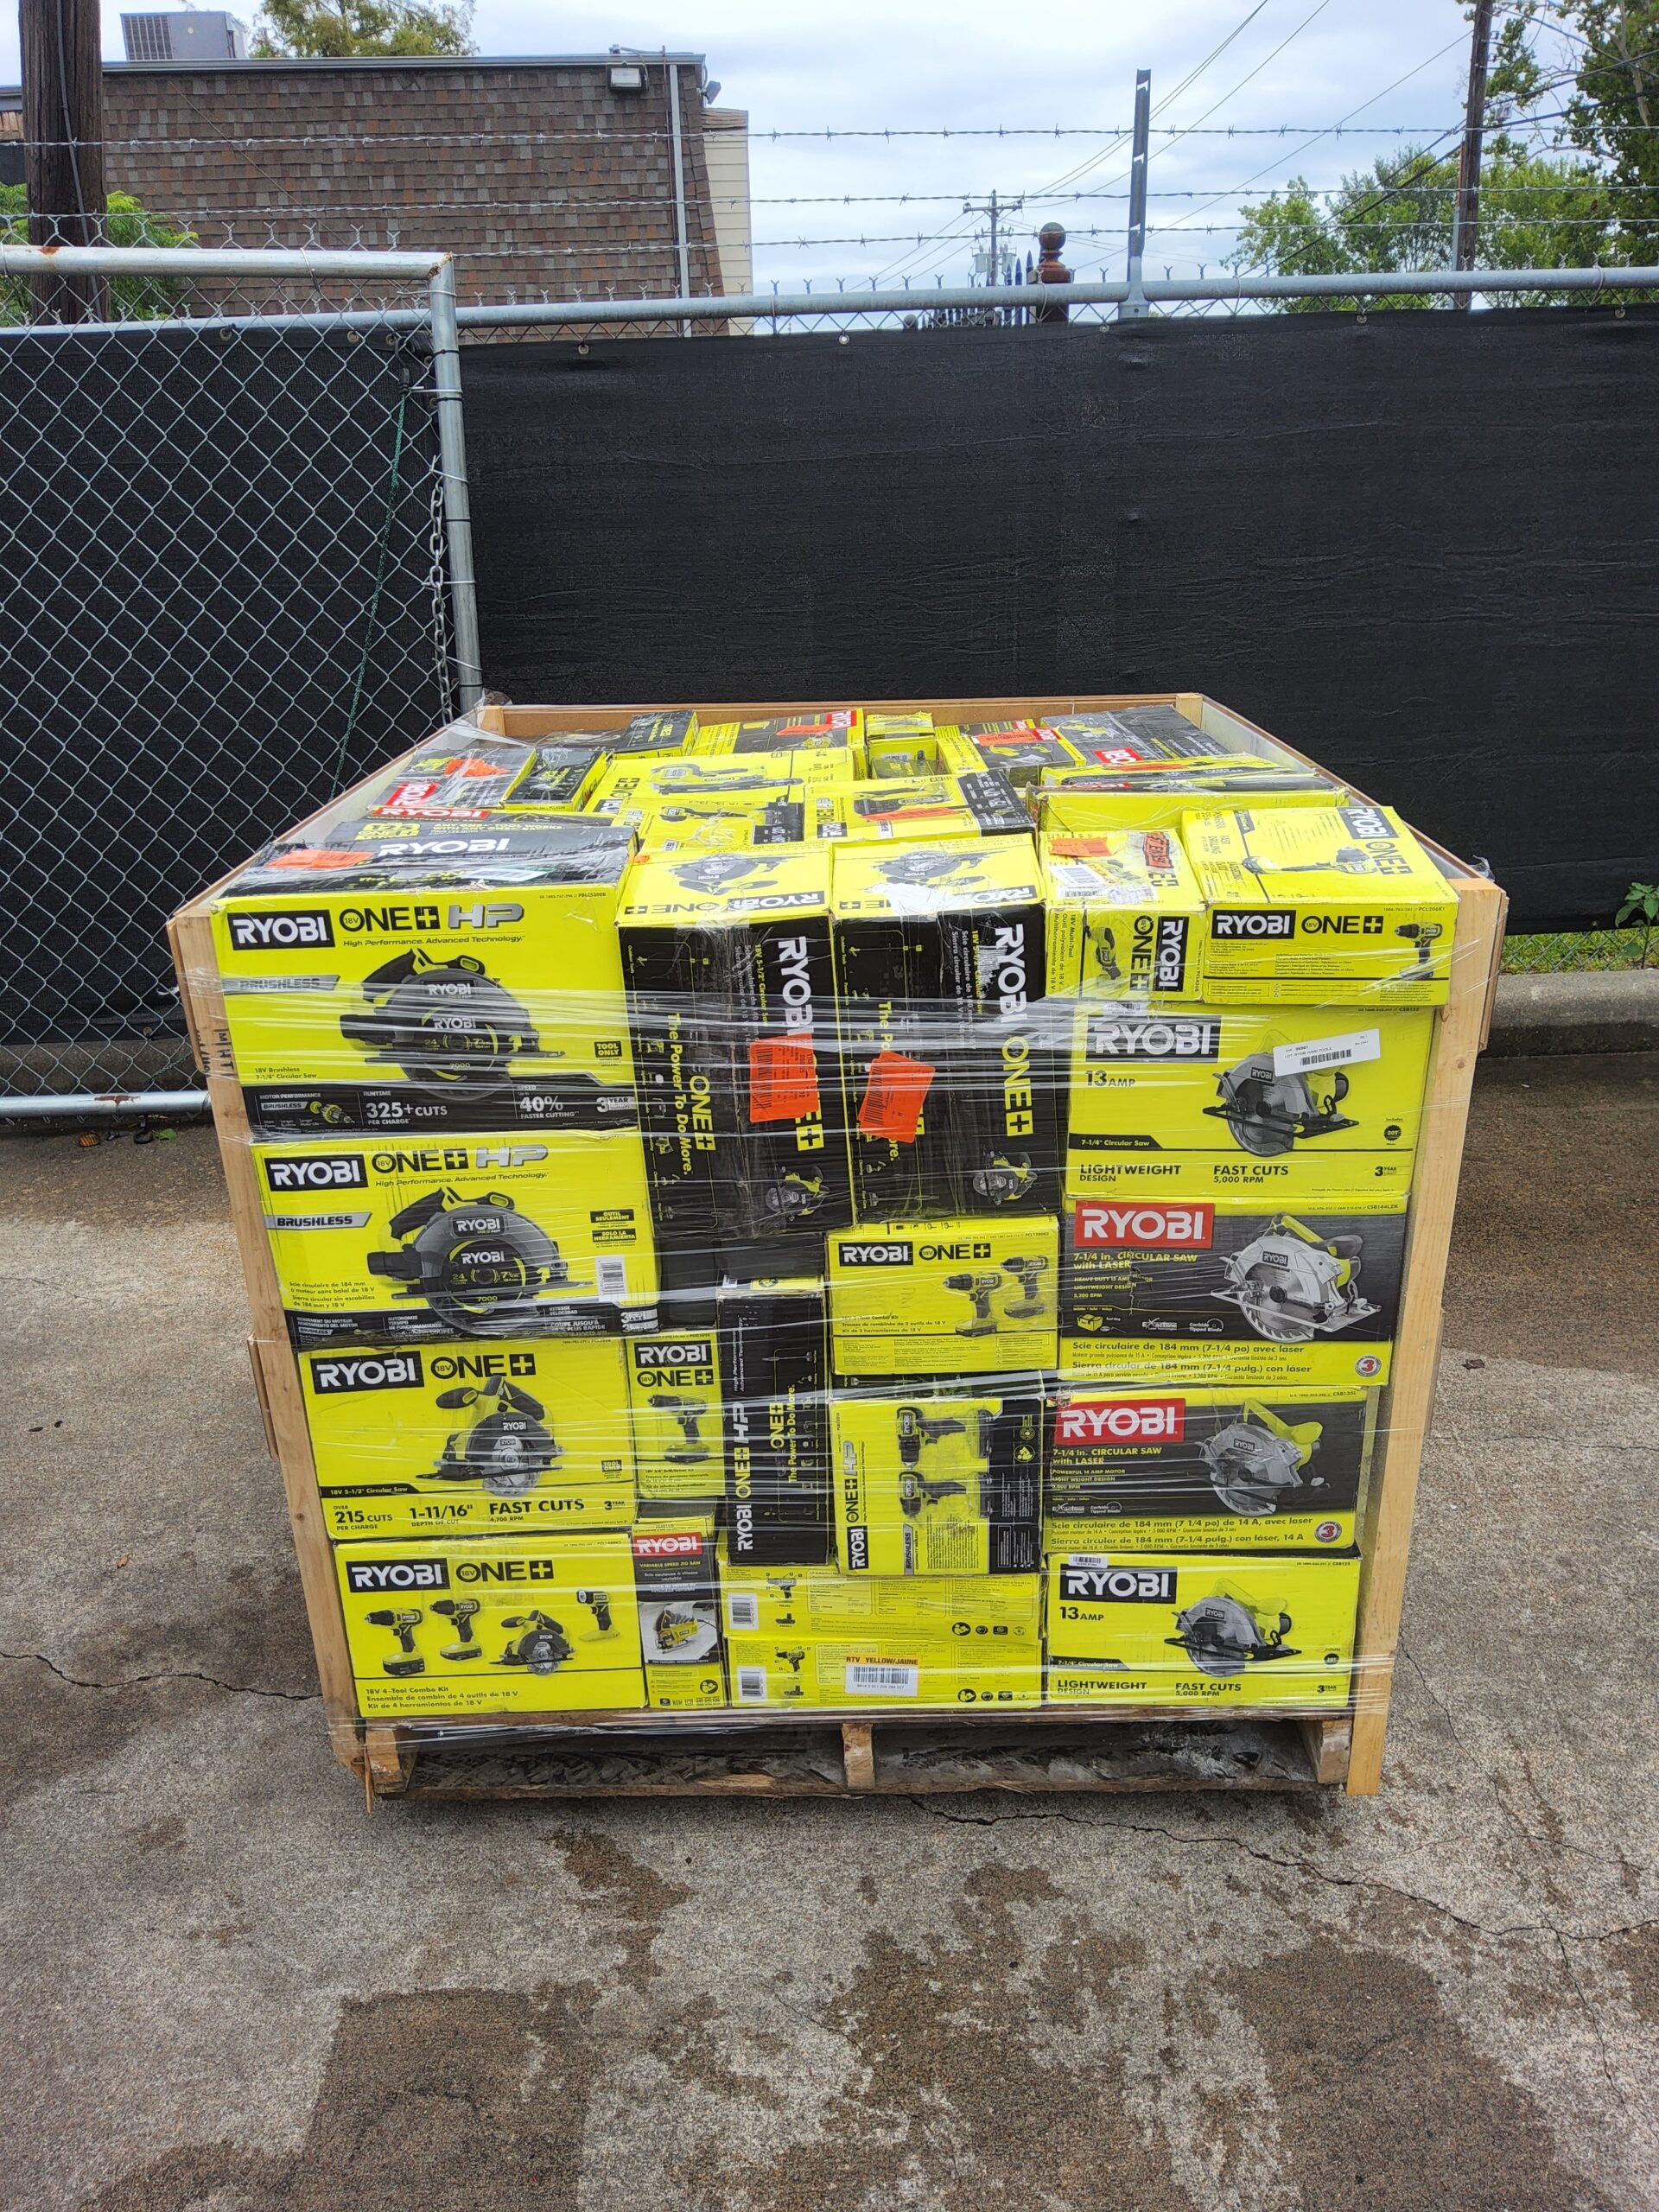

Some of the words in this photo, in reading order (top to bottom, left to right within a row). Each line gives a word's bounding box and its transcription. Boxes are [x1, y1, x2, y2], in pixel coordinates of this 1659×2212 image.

[1346, 809, 1390, 838] RYOBI
[378, 838, 508, 856] RYOBI
[232, 917, 328, 944] RYOBI
[448, 903, 524, 929] HP
[1217, 916, 1289, 934] RYOBI
[1160, 919, 1184, 987] RYOBI
[995, 924, 1027, 1023] RYOBI
[240, 978, 320, 989] BRUSHLESS
[429, 983, 471, 996] RYOBI
[778, 937, 813, 1035] RYOBI
[878, 1001, 892, 1028] The
[433, 1018, 476, 1029] RYOBI
[667, 1014, 681, 1040] The
[1094, 1025, 1210, 1054] RYOBI
[671, 1044, 683, 1090] Power
[1253, 1069, 1272, 1079] RYOBI
[1085, 1071, 1107, 1086] 13
[1109, 1078, 1135, 1087] AMP
[520, 1096, 563, 1113] 40%
[597, 1097, 609, 1112] 3
[674, 1094, 684, 1109] To
[676, 1114, 689, 1134] Do
[679, 1136, 692, 1175] More.
[888, 1138, 899, 1161] ore.
[270, 1160, 361, 1185] RYOBI
[476, 1144, 549, 1167] HP
[1080, 1165, 1181, 1175] LIGHTWEIGHT
[1214, 1166, 1248, 1175] FAST
[1253, 1166, 1288, 1175] CUTS
[277, 1216, 353, 1227] BRUSHLESS
[456, 1218, 499, 1231] RYOBI
[1082, 1209, 1203, 1239] RYOBI
[461, 1251, 505, 1264] RYOBI
[842, 1247, 908, 1262] RYOBI
[1263, 1253, 1287, 1264] RYOBI
[1099, 1260, 1131, 1268] LASER
[638, 1344, 707, 1364] RYOBI
[1234, 1345, 1250, 1354] po)
[317, 1358, 416, 1387] RYOBI
[1362, 1360, 1375, 1373] 3
[503, 1421, 526, 1431] RYOBI
[733, 1403, 749, 1444] HP
[787, 1413, 795, 1426] Do
[1061, 1407, 1175, 1438] RYOBI
[787, 1427, 796, 1437] To
[788, 1440, 797, 1465] Power
[1235, 1440, 1255, 1451] RYOBI
[843, 1440, 857, 1476] HP
[788, 1467, 797, 1483] The
[410, 1504, 473, 1520] 1-11/16"
[490, 1501, 531, 1515] FAST
[539, 1499, 584, 1511] CUTS
[604, 1501, 612, 1510] 3
[334, 1511, 364, 1523] 215
[738, 1505, 753, 1551] RYOBI
[1322, 1526, 1335, 1537] 3
[637, 1536, 697, 1554] RYOBI
[1176, 1535, 1202, 1544] (7-1/4
[1205, 1534, 1232, 1543] pulg.)
[851, 1529, 865, 1568] RYOBI
[352, 1564, 442, 1586] RYOBI
[1066, 1571, 1168, 1597] RYOBI
[1060, 1607, 1078, 1619] 13
[1206, 1610, 1224, 1618] RYOBI
[1058, 1680, 1147, 1689] LIGHTWEIGHT
